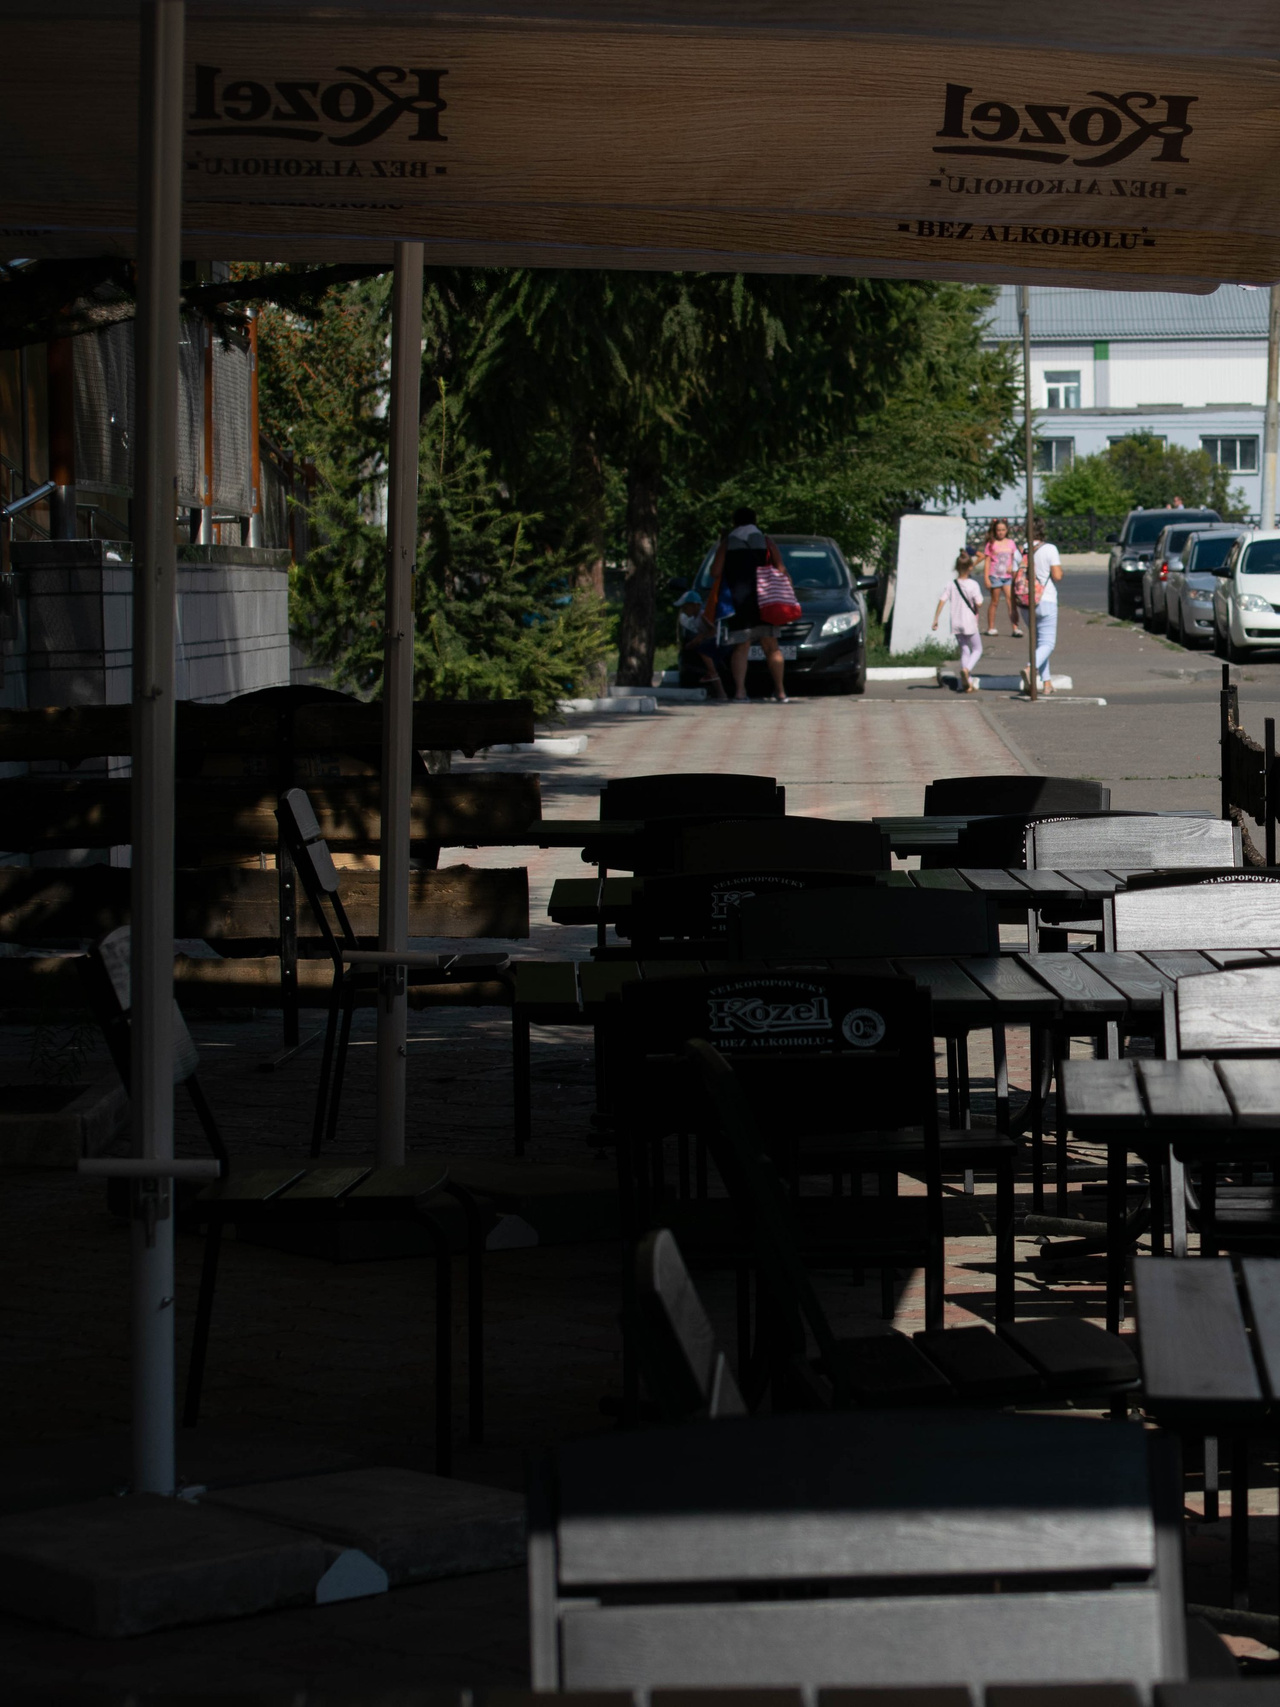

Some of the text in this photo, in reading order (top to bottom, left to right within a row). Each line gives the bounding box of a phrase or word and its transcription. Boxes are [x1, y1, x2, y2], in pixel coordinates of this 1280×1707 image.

[917, 220, 973, 240] BEZ
[706, 996, 833, 1034] Kozel
[719, 1036, 827, 1048] BEZ ALKOHOLU
